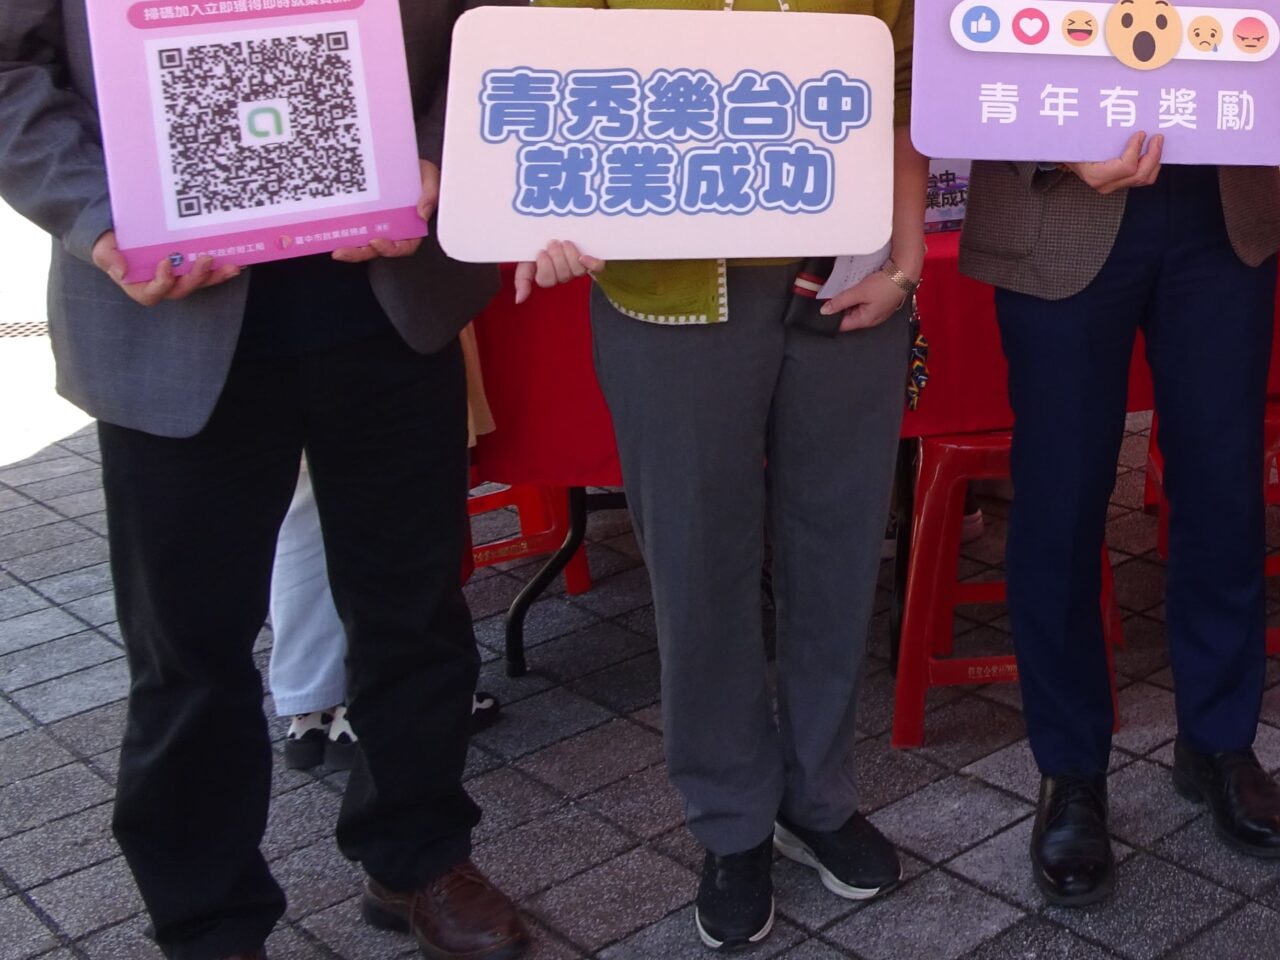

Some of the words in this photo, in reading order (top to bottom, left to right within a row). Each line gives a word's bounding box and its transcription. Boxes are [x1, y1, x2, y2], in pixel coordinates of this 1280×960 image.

[481, 67, 871, 143] 青秀樂台中
[978, 81, 1255, 132] 青年有獎勵
[512, 141, 836, 216] 就業成功
